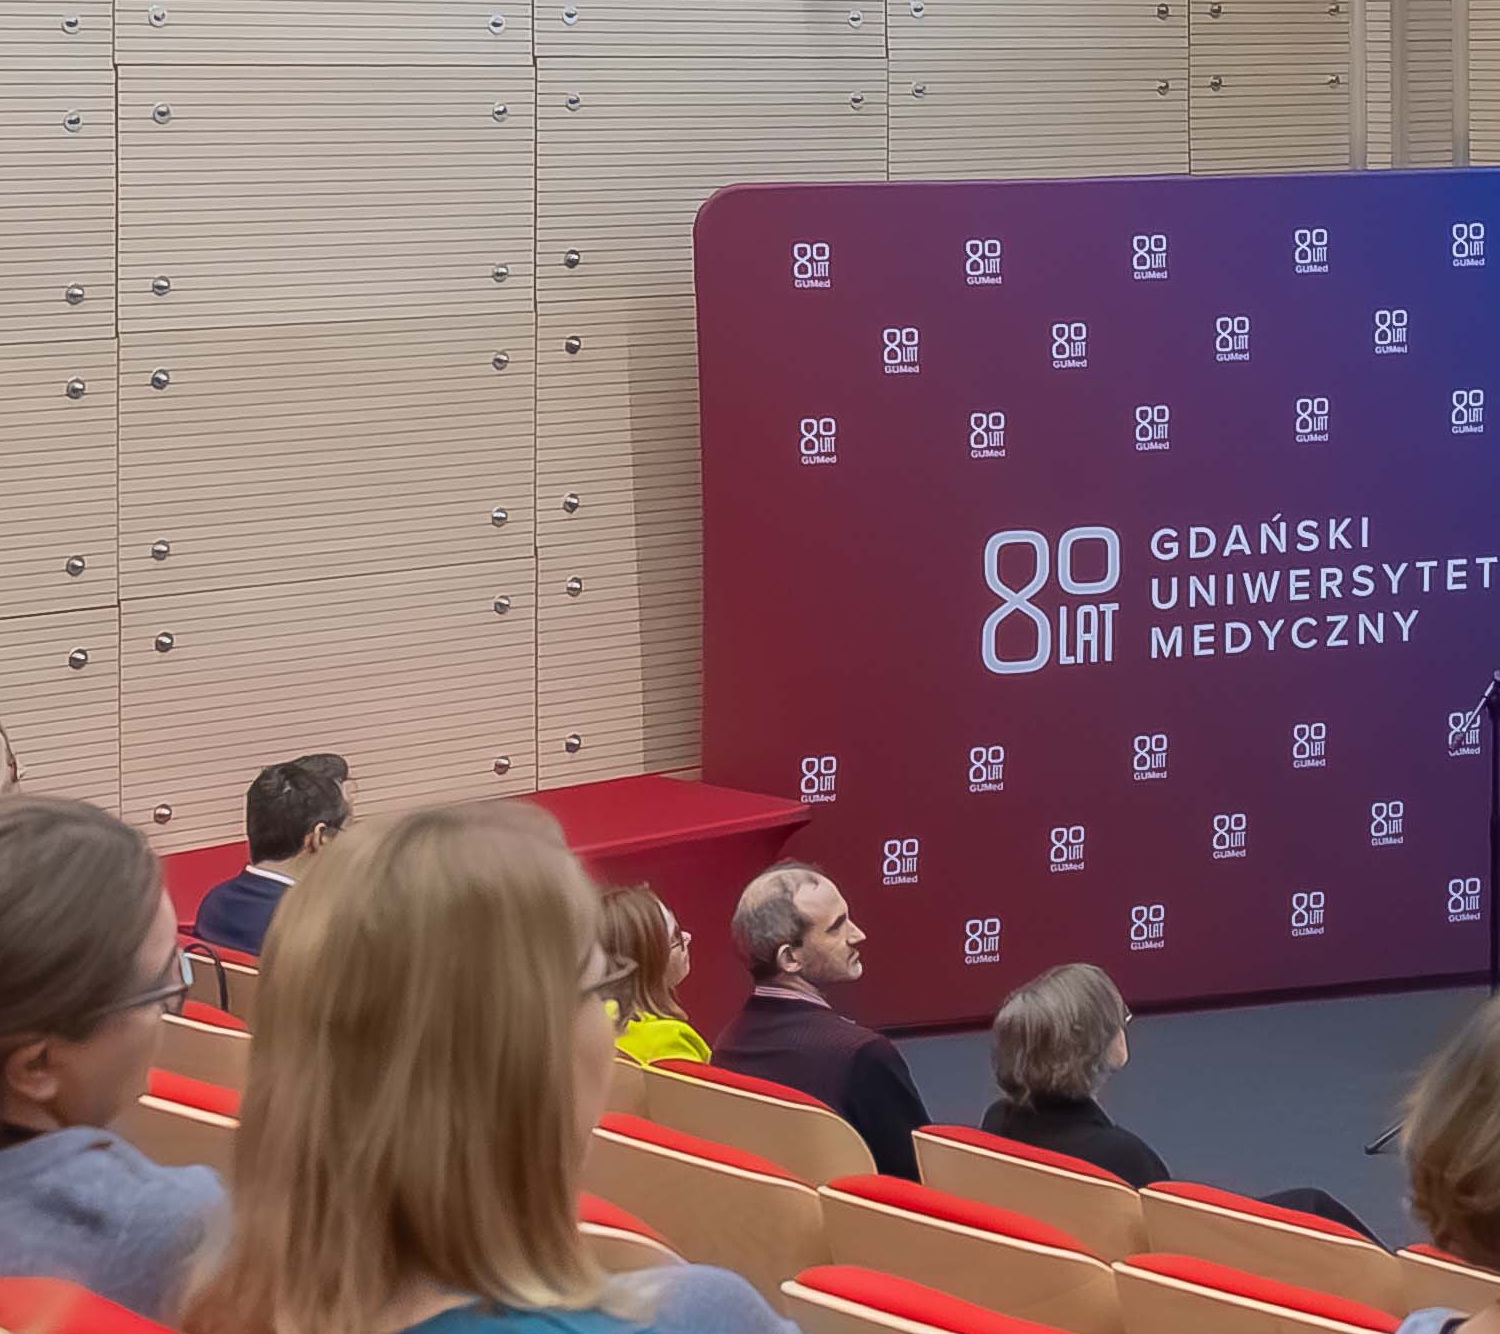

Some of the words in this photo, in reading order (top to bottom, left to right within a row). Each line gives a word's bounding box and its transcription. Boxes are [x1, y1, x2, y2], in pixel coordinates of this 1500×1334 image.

[965, 238, 1001, 274] 80
[1133, 235, 1166, 269] 80
[1294, 229, 1327, 263] 80
[1452, 223, 1484, 257] 80
[793, 243, 829, 278] 80
[1052, 323, 1086, 358] 80
[1214, 317, 1248, 352] 80
[1375, 310, 1406, 344] 80
[883, 328, 918, 363] 80
[1136, 405, 1168, 440] 80
[1296, 398, 1327, 432] 80
[1452, 389, 1483, 424] 80
[800, 418, 836, 453] 80
[970, 412, 1004, 447] 80
[1150, 512, 1370, 561] GDAŃSKI
[981, 526, 1121, 675] 80
[1150, 556, 1499, 610] UNIWERSYTET
[1058, 602, 1120, 665] LAT
[1150, 609, 1420, 659] MEDYCZNY
[1133, 734, 1166, 769] 80
[1293, 723, 1325, 758] 80
[801, 756, 835, 791] 80
[969, 746, 1003, 781] 80
[1213, 814, 1245, 849] 80
[1371, 801, 1402, 836] 80
[883, 839, 917, 874] 80
[1050, 826, 1083, 861] 80
[1292, 892, 1323, 926] 80
[1447, 878, 1479, 912] 80
[965, 918, 999, 953] 80
[1130, 905, 1163, 940] 80
